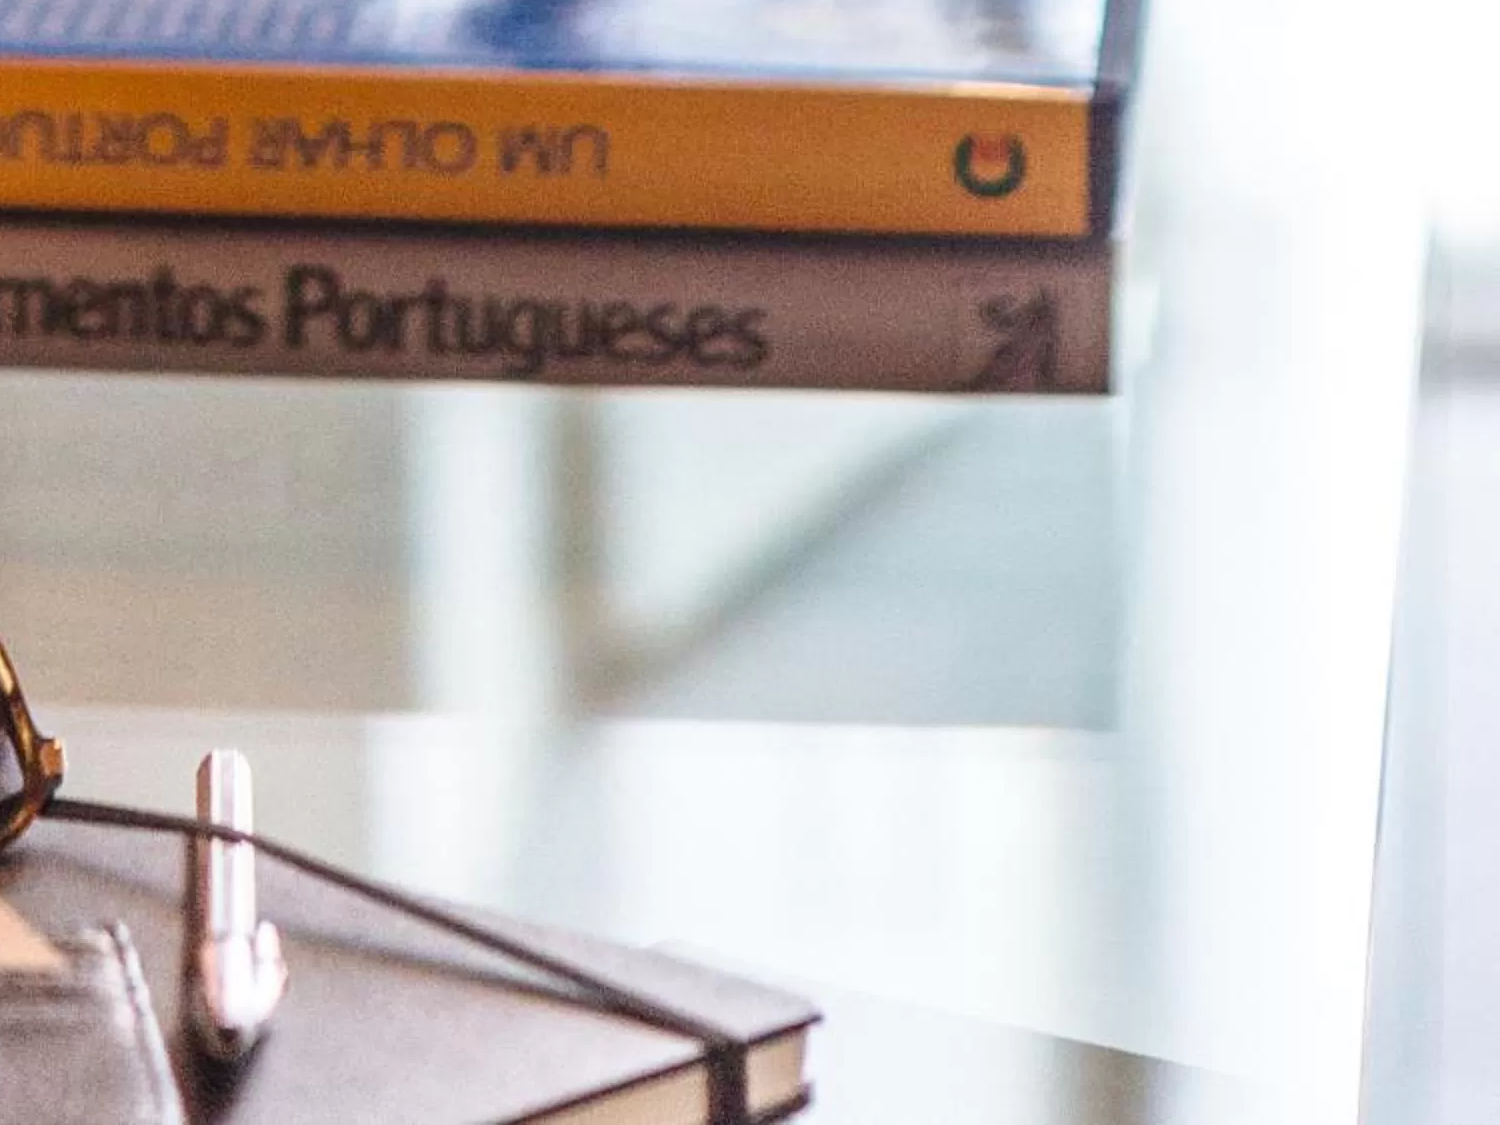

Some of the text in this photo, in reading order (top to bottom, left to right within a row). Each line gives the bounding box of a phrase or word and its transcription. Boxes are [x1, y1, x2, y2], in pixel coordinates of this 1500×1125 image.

[250, 117, 477, 172] OLHAR
[501, 125, 608, 174] UM
[284, 262, 768, 376] Portugueses
